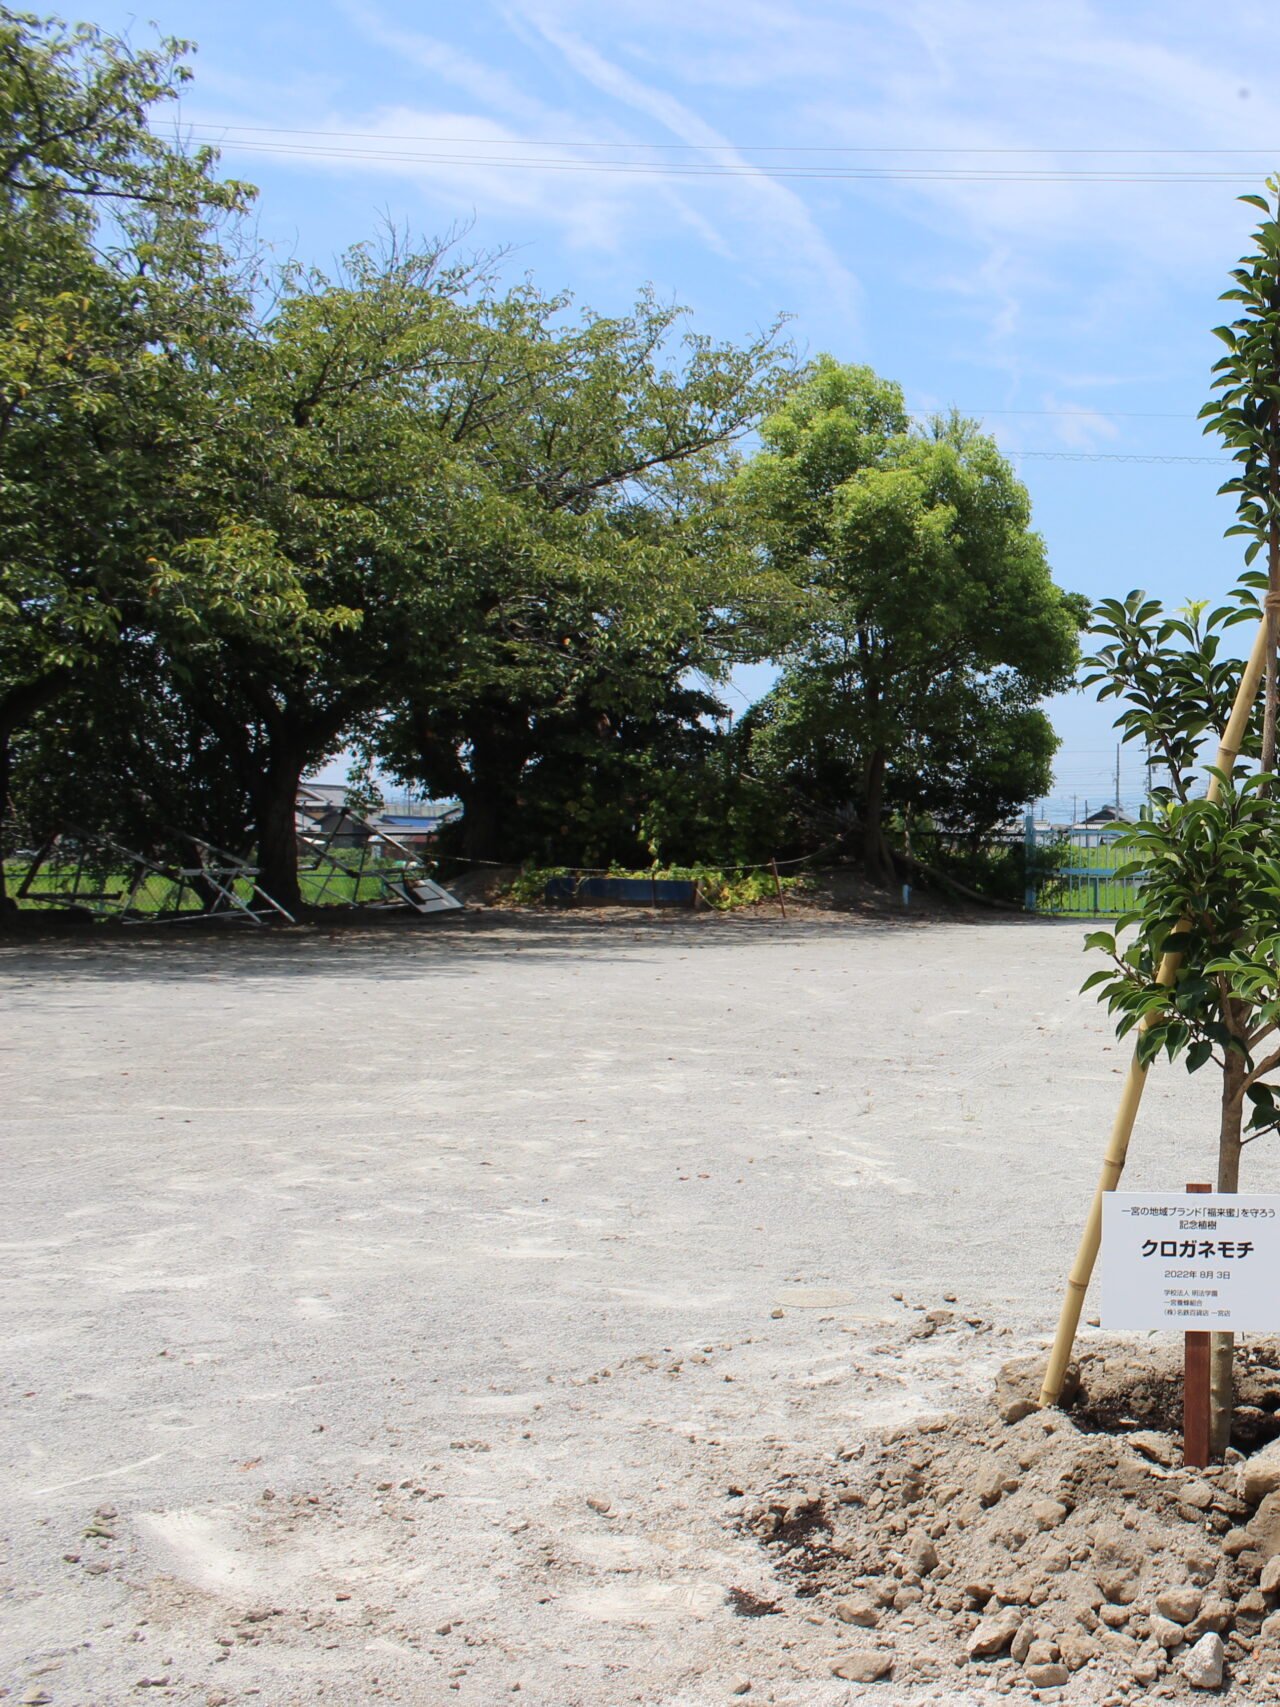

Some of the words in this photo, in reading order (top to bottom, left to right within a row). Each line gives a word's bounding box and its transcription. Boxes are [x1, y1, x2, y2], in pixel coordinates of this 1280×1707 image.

[1179, 1219, 1217, 1230] 記念植樹
[1141, 1239, 1255, 1259] クロガネモチ
[1164, 1270, 1196, 1279] 2022年
[1199, 1271, 1214, 1279] 8月
[1216, 1271, 1231, 1280] 3日
